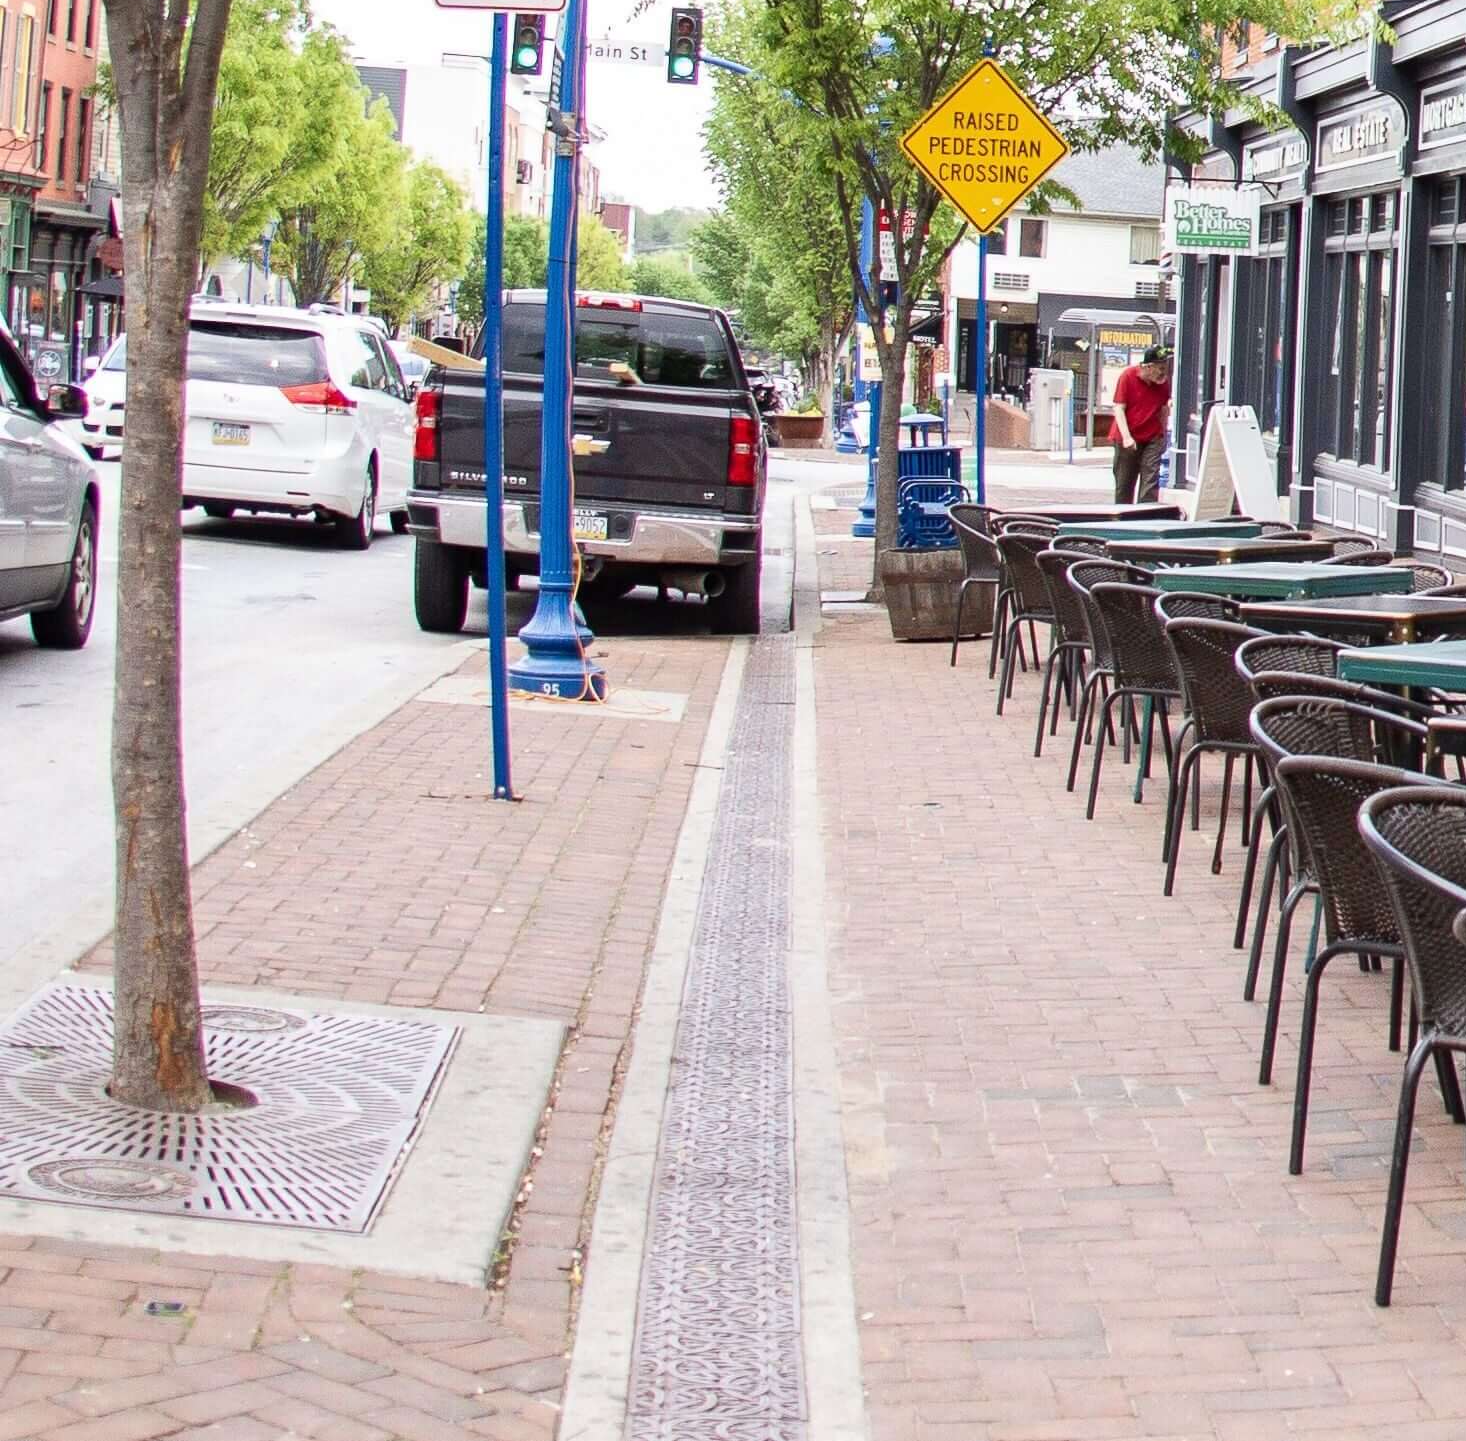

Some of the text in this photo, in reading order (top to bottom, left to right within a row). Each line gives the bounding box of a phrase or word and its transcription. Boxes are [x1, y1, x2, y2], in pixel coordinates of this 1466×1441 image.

[630, 46, 648, 61] St
[953, 111, 1019, 131] RAISED
[1333, 116, 1388, 153] REAL ESTATE
[929, 136, 1042, 158] PEDESTRIAN
[939, 162, 1029, 184] CROSSING
[1174, 199, 1228, 220] Better
[1191, 217, 1251, 235] Homes
[450, 470, 528, 486] SILVEDO
[543, 682, 560, 697] 95
